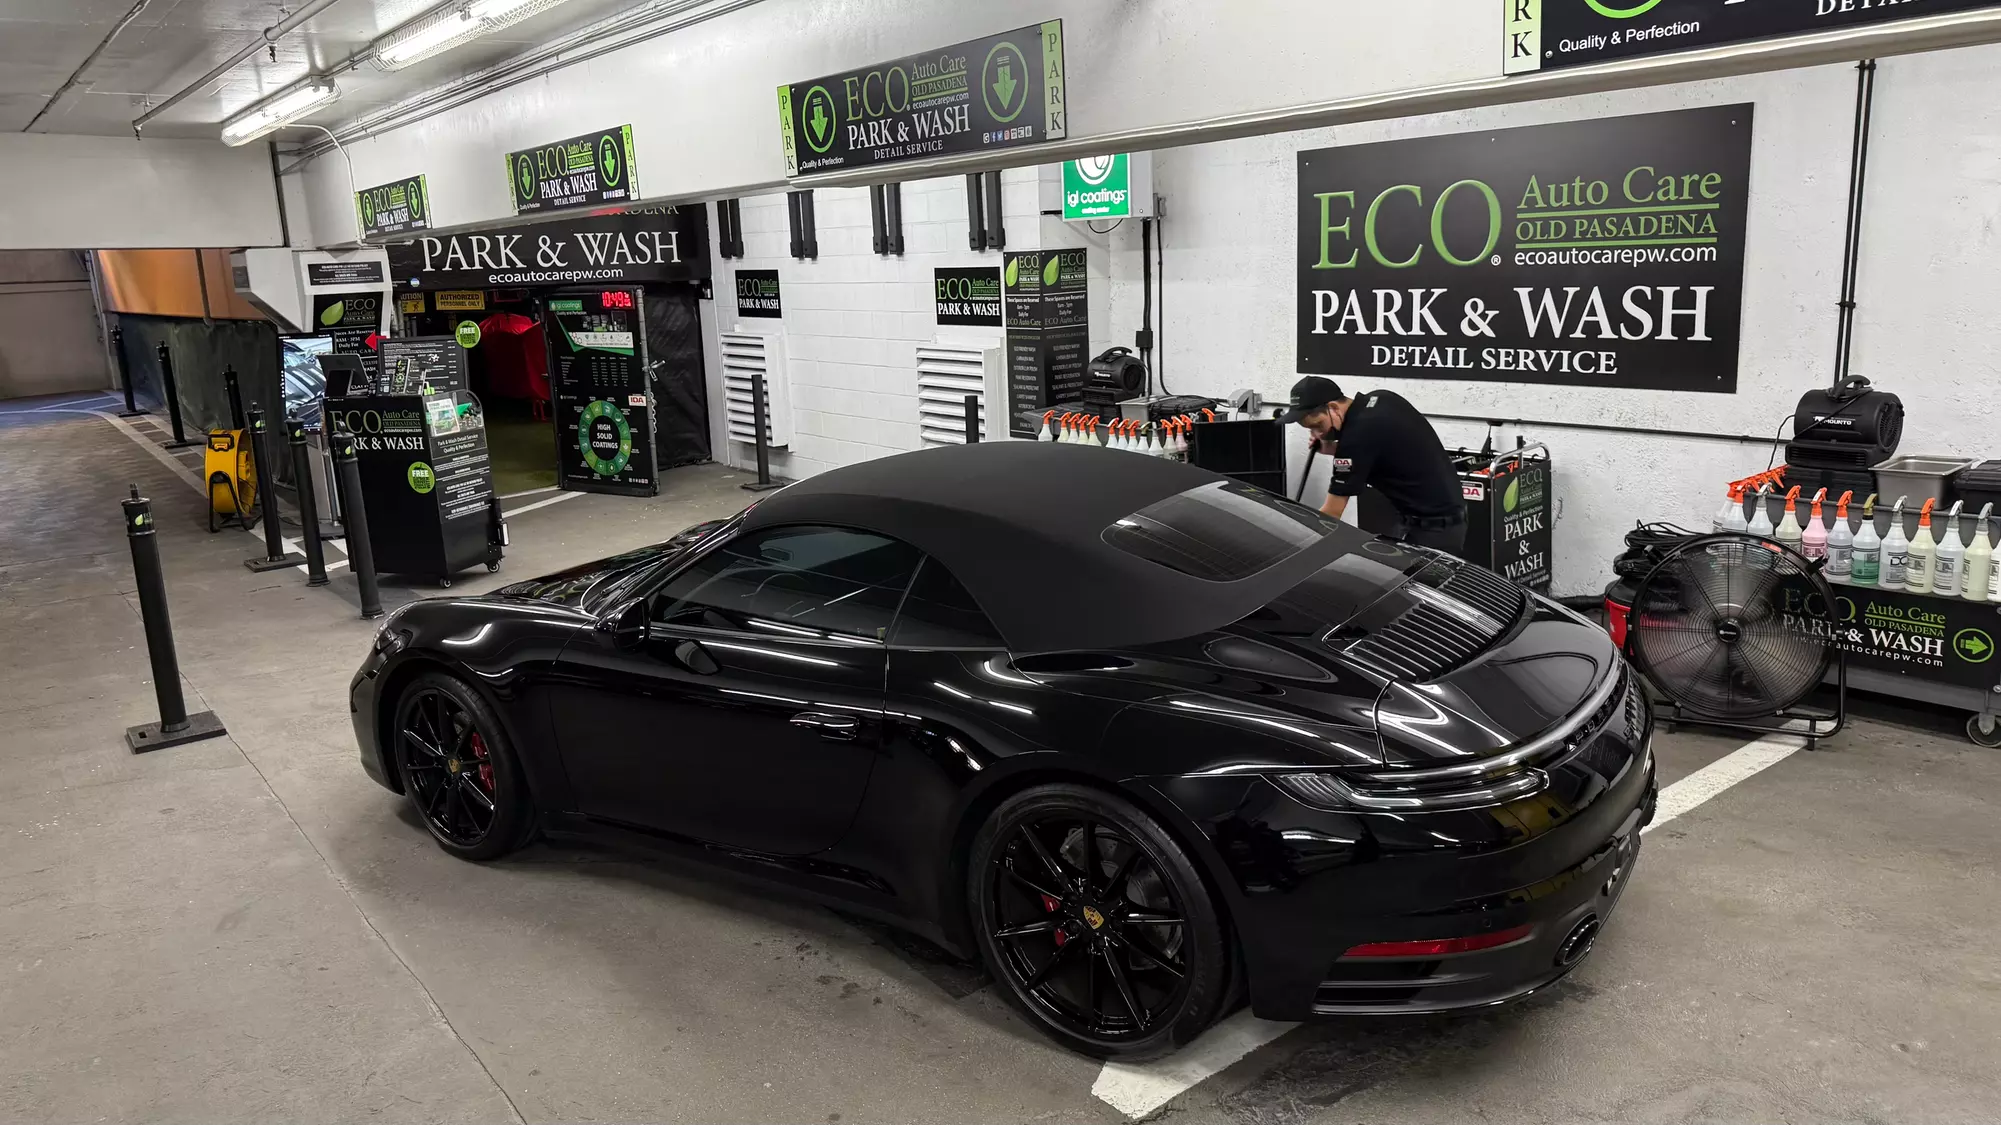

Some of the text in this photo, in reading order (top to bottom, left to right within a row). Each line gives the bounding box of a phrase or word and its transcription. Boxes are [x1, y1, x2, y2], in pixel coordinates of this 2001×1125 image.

[1559, 20, 1700, 53] Quality & Perfection
[912, 54, 966, 80] Auto Care
[912, 76, 968, 97] OLD PASADENA
[1048, 33, 1062, 131] PARK
[842, 66, 909, 122] ECO
[912, 92, 969, 110] ecoautocarepw.com
[781, 95, 796, 170] PARK
[847, 103, 971, 150] PARK & WASH
[567, 140, 592, 156] Auto Care
[874, 139, 944, 160] DETAIL SERVICE
[536, 145, 568, 180] ECO
[626, 132, 637, 194] PARK
[802, 159, 817, 169] Quality
[822, 155, 844, 166] Perfection
[540, 172, 598, 199] PARK & WASH
[1517, 166, 1721, 209] Auto Care
[373, 187, 391, 212] ECO
[554, 194, 587, 206] DETAIL SERVICE
[1067, 188, 1126, 207] igl coatings
[376, 208, 409, 227] PARK & WASH
[1516, 213, 1717, 241] OLD PASADENA
[420, 231, 681, 272] PARK & WASH
[1061, 253, 1085, 266] ECO
[1515, 246, 1717, 267] ecoautocarepw.com
[1019, 256, 1039, 268] ECO
[488, 267, 624, 285] ecoautocarepw.com
[972, 278, 999, 286] Auto Care
[737, 278, 760, 296] ECO
[937, 278, 971, 300] ECO
[345, 299, 375, 310] ECO
[602, 292, 624, 307] 10:49
[739, 298, 779, 309] PARK & WASH
[938, 303, 1000, 316] PARK & WASH
[1312, 285, 1714, 341] PARK & WASH
[1371, 345, 1617, 374] DETAIL SERVICE
[382, 410, 420, 419] Auto Care
[371, 436, 381, 450] &
[383, 437, 424, 450] WASH
[592, 441, 618, 449] COATINGS
[1520, 468, 1543, 488] ECO
[1463, 488, 1480, 496] DA
[1504, 513, 1519, 523] Quality
[1523, 505, 1544, 516] Perfection
[1505, 512, 1544, 542] PARK
[1519, 540, 1530, 555] &
[1504, 552, 1544, 580] WASH
[1865, 601, 1946, 624] Auto Care
[1865, 618, 1944, 637] OLD PASADENA
[1846, 628, 1864, 643] &
[1869, 628, 1944, 657] WASH
